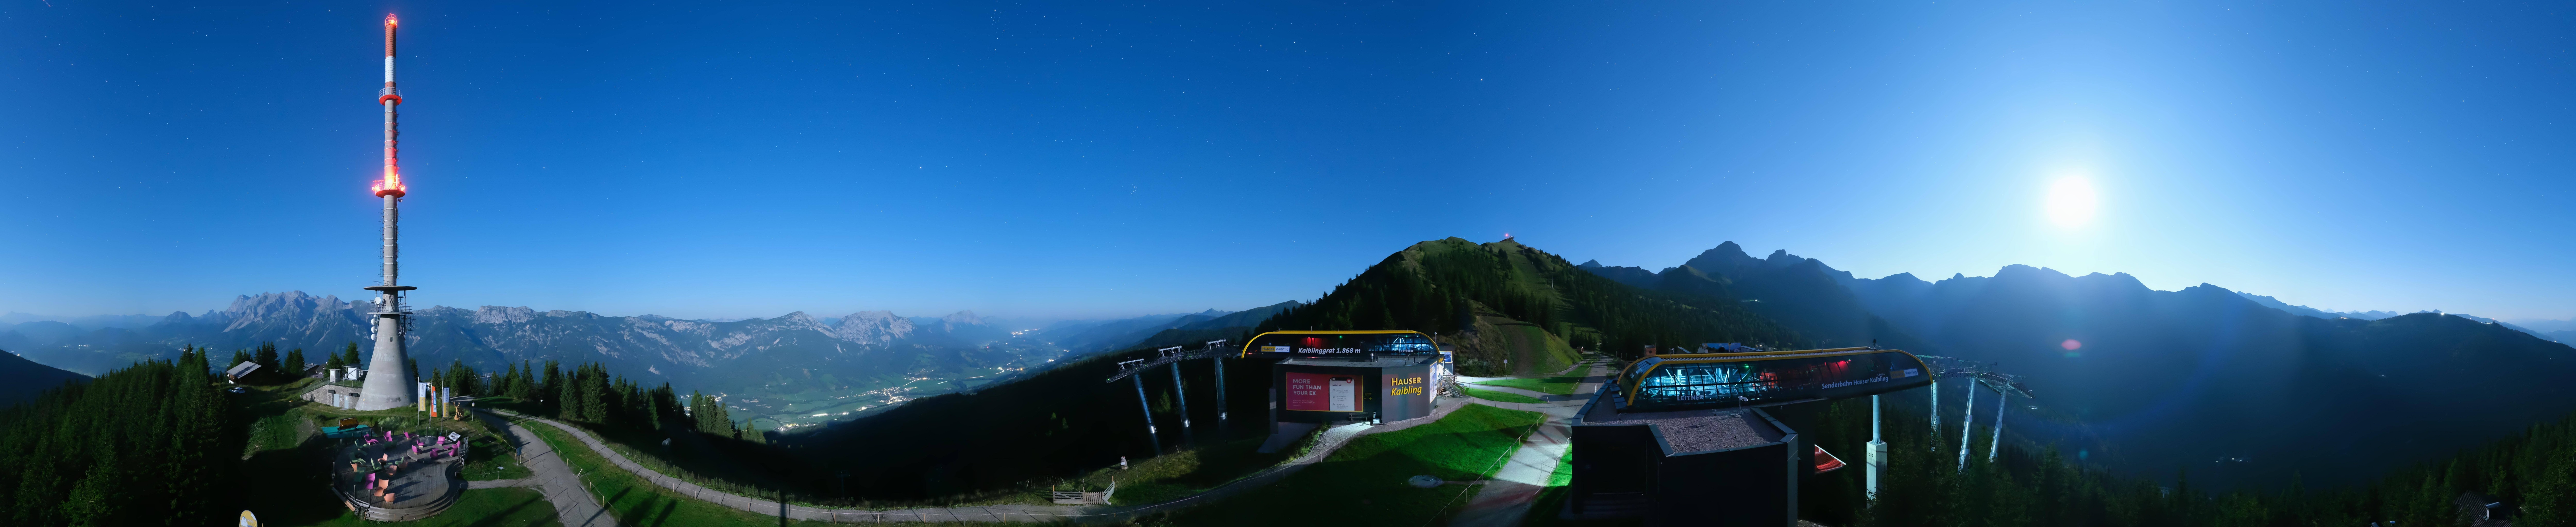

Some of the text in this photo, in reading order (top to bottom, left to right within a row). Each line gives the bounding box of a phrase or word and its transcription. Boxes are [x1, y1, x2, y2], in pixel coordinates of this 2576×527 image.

[1392, 377, 1421, 386] HAUSER
[1822, 380, 1852, 389] Senderbahn
[1391, 386, 1422, 396] Kaibling
